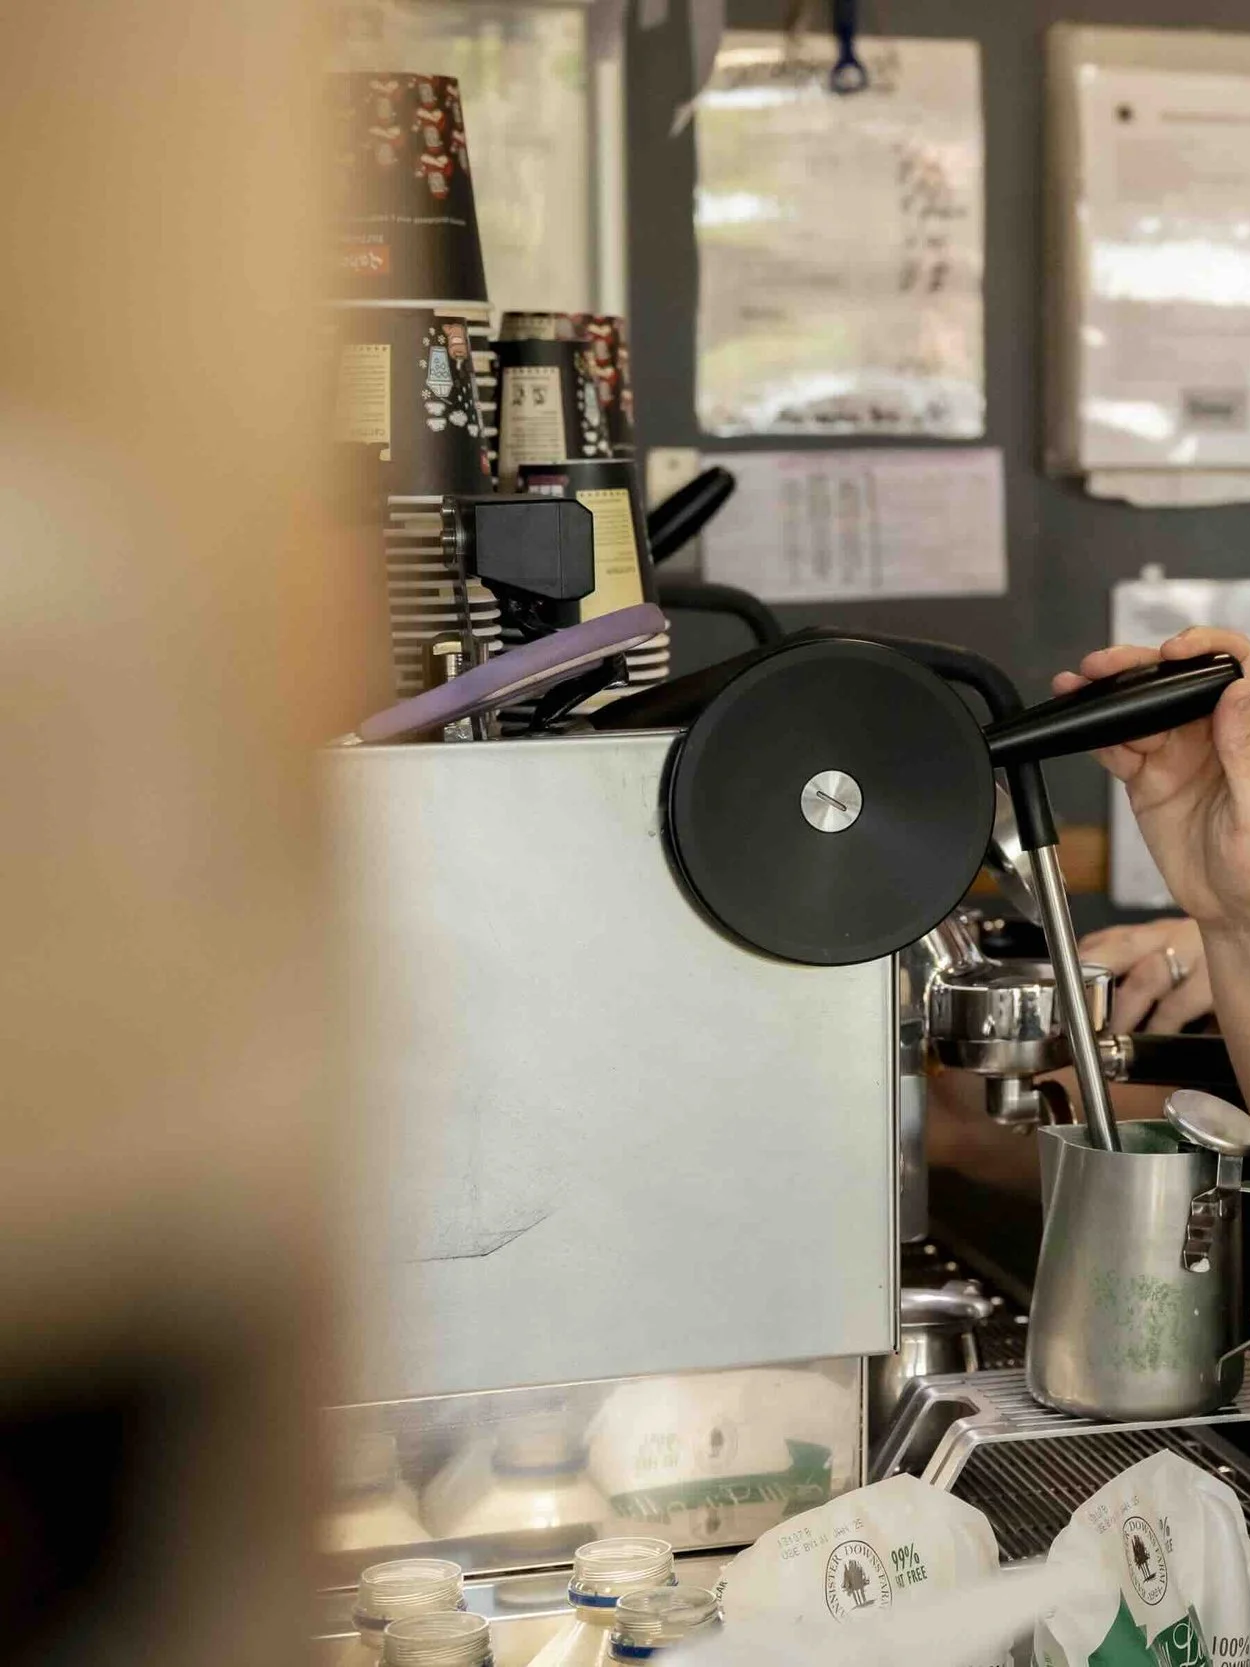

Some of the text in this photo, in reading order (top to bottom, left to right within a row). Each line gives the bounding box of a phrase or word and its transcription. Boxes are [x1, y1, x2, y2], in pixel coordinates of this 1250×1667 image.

[844, 1545, 881, 1573] DOWNS
[891, 1542, 920, 1572] 99%
[907, 1565, 928, 1585] FREE
[1212, 1635, 1250, 1658] 100%
